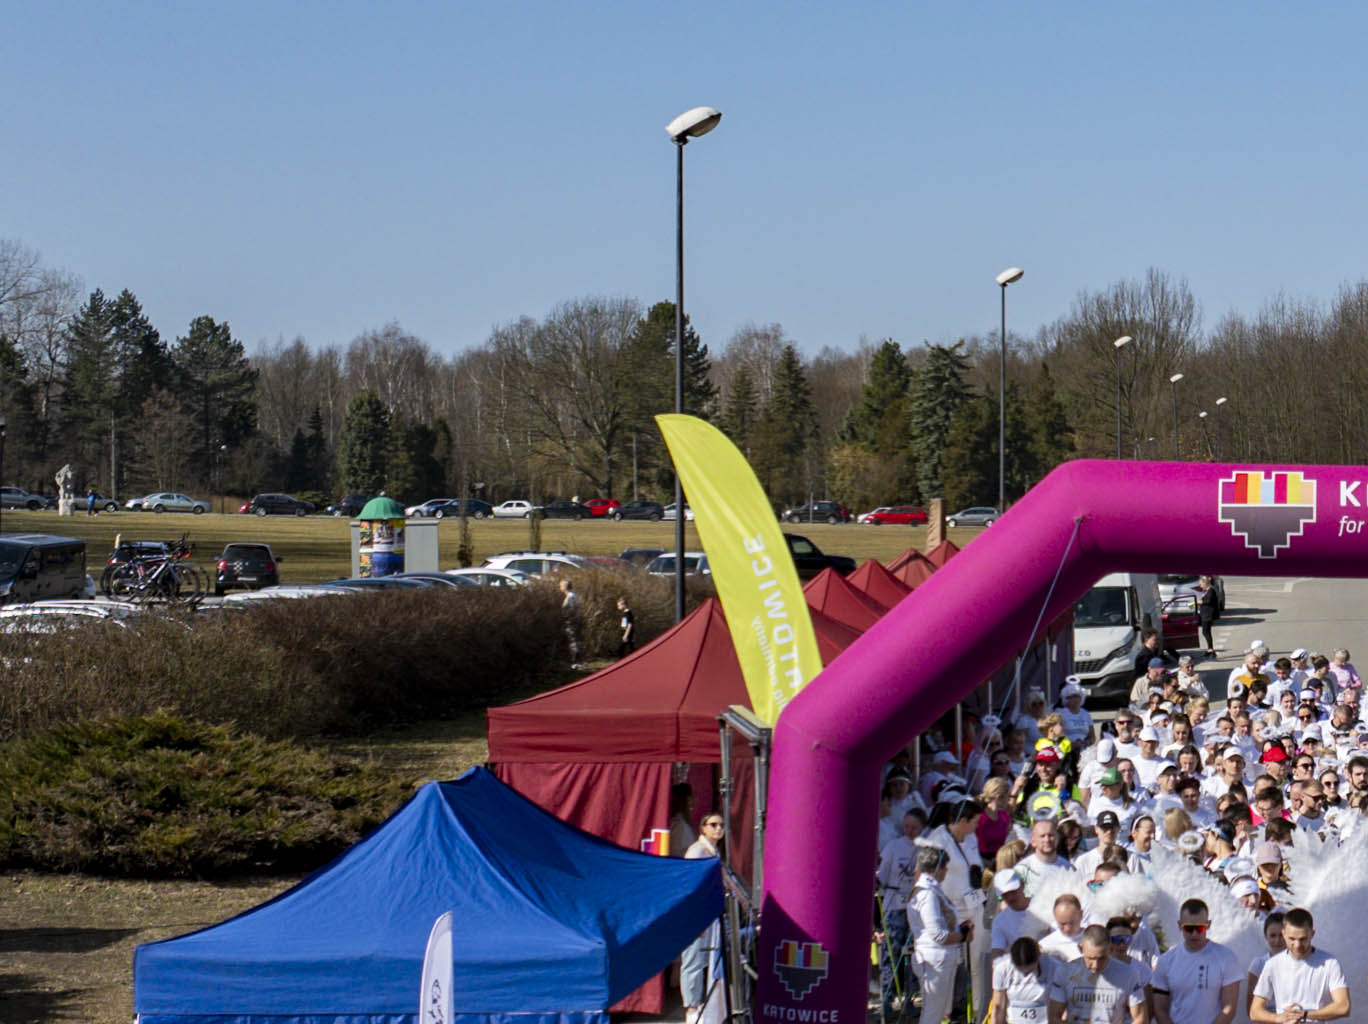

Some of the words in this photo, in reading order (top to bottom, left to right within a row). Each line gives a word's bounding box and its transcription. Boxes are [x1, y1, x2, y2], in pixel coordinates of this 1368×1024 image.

[1338, 516, 1365, 537] for
[763, 1003, 839, 1024] KATOWICE
[1020, 1007, 1037, 1021] 43
